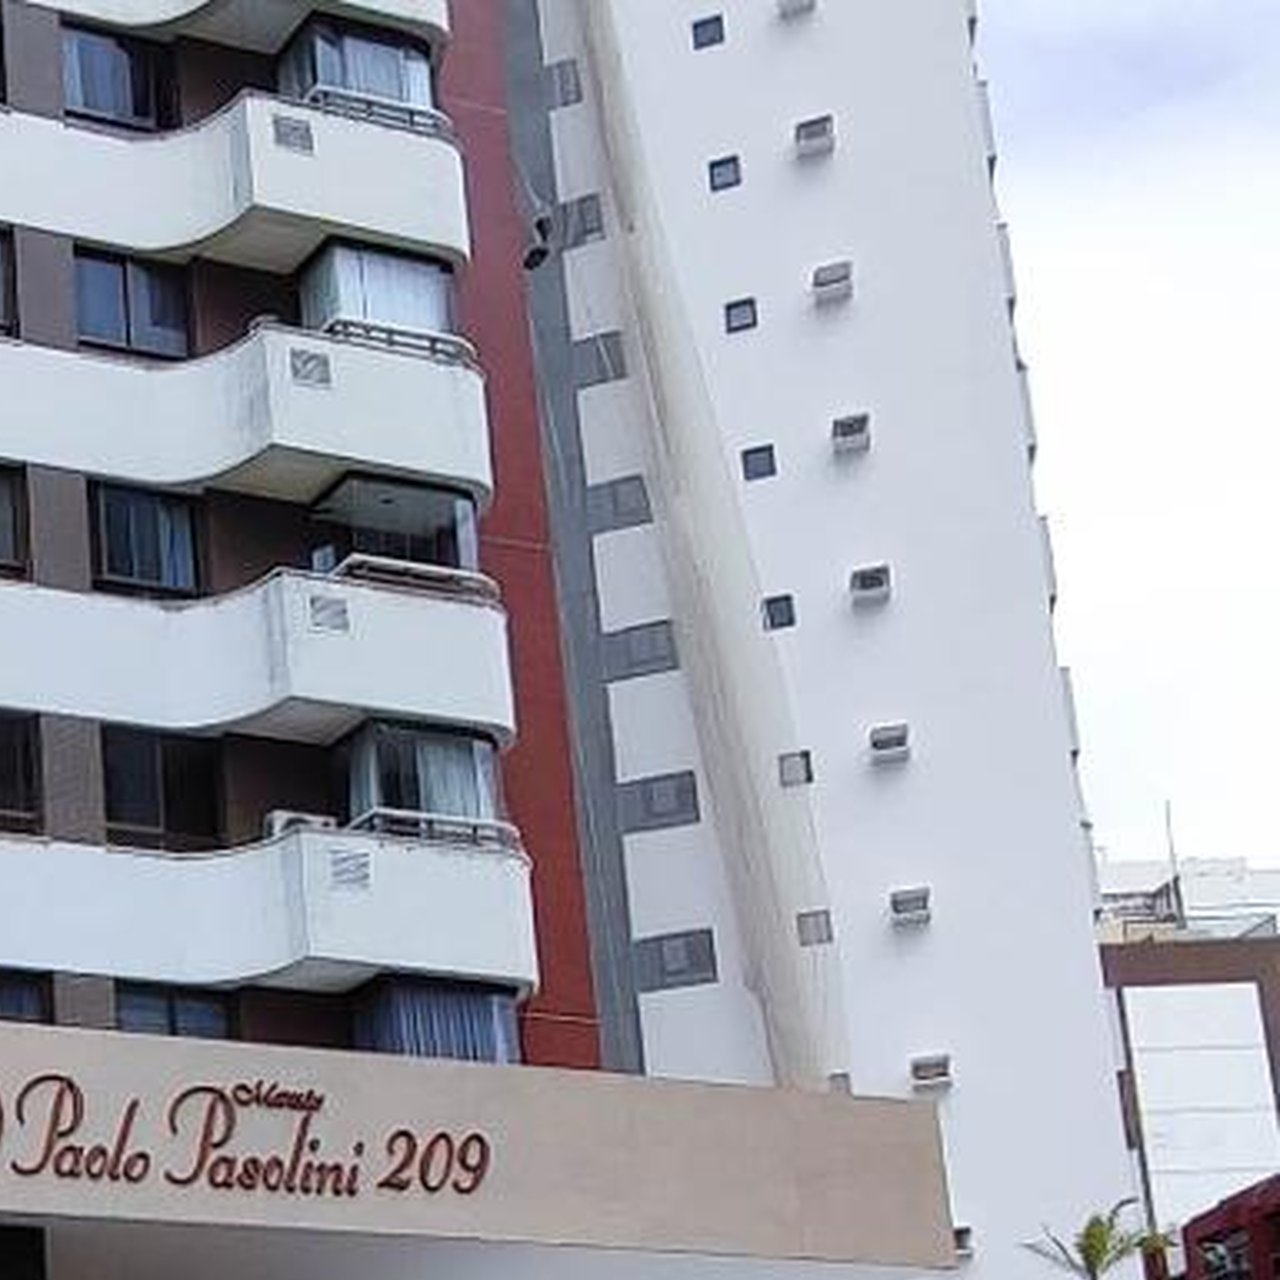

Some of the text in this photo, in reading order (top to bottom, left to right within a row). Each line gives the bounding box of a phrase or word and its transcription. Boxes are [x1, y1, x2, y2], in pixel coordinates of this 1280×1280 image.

[10, 1074, 491, 1197] Paolo Pasolini 209
